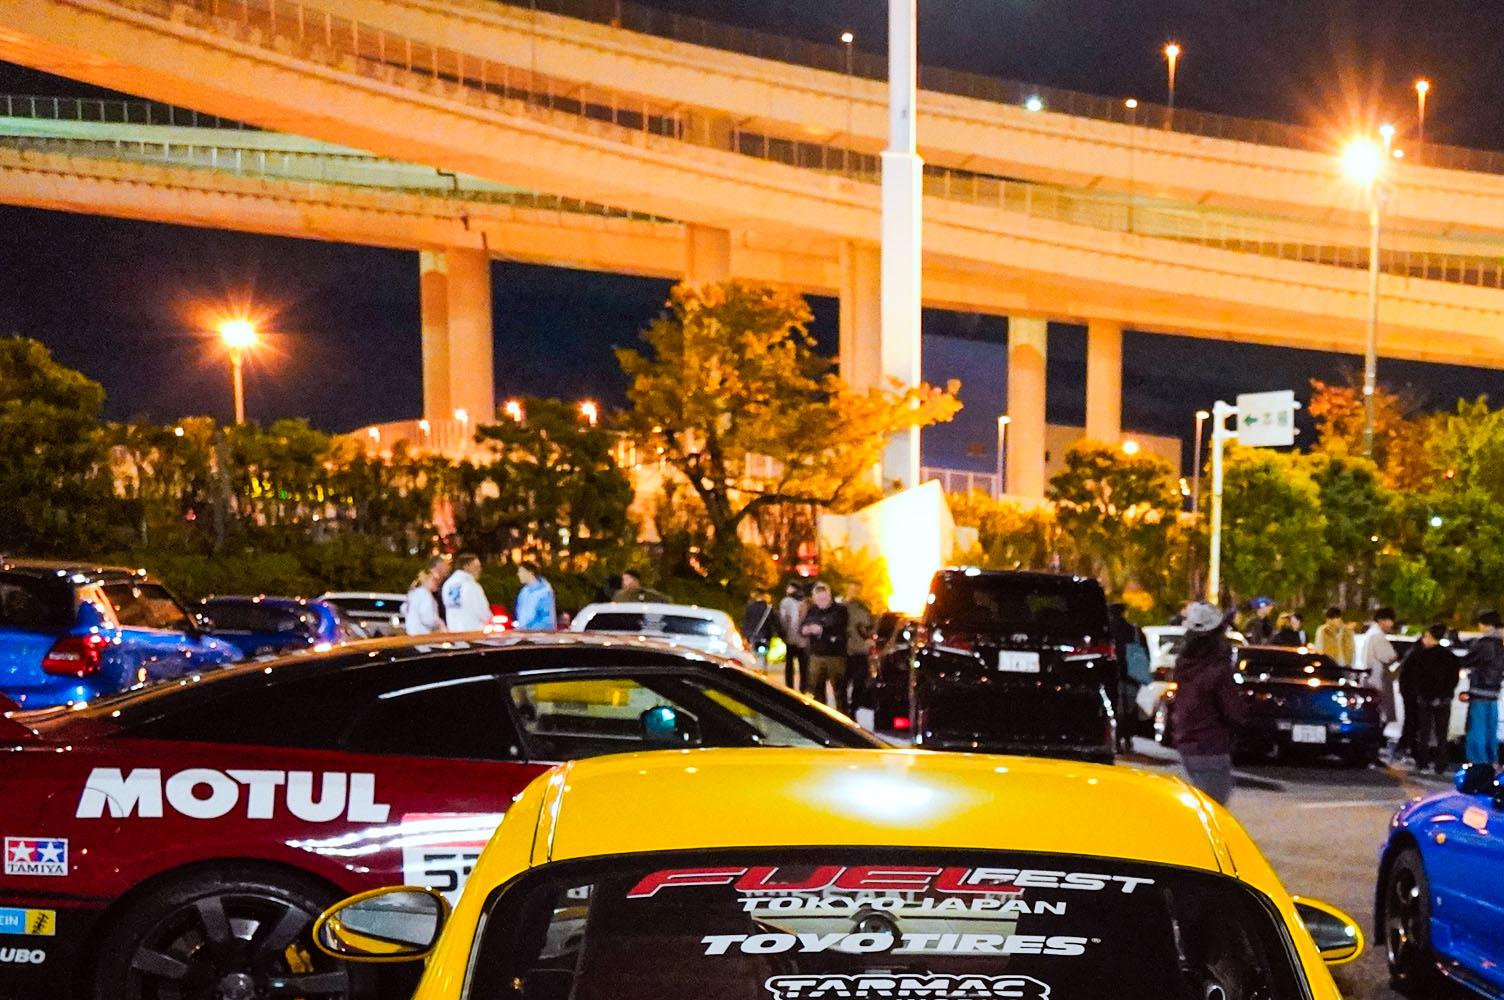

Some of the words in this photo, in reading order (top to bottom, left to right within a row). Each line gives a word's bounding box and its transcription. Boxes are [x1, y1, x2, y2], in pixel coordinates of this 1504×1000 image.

[75, 767, 392, 823] MOTUL
[8, 864, 64, 873] TAMIYA
[423, 854, 480, 891] 5
[737, 896, 907, 912] TOKYO
[908, 897, 1067, 916] JAPAN
[701, 932, 895, 956] TOYO
[891, 933, 1088, 957] TIRES
[776, 979, 1026, 998] TARMAC
